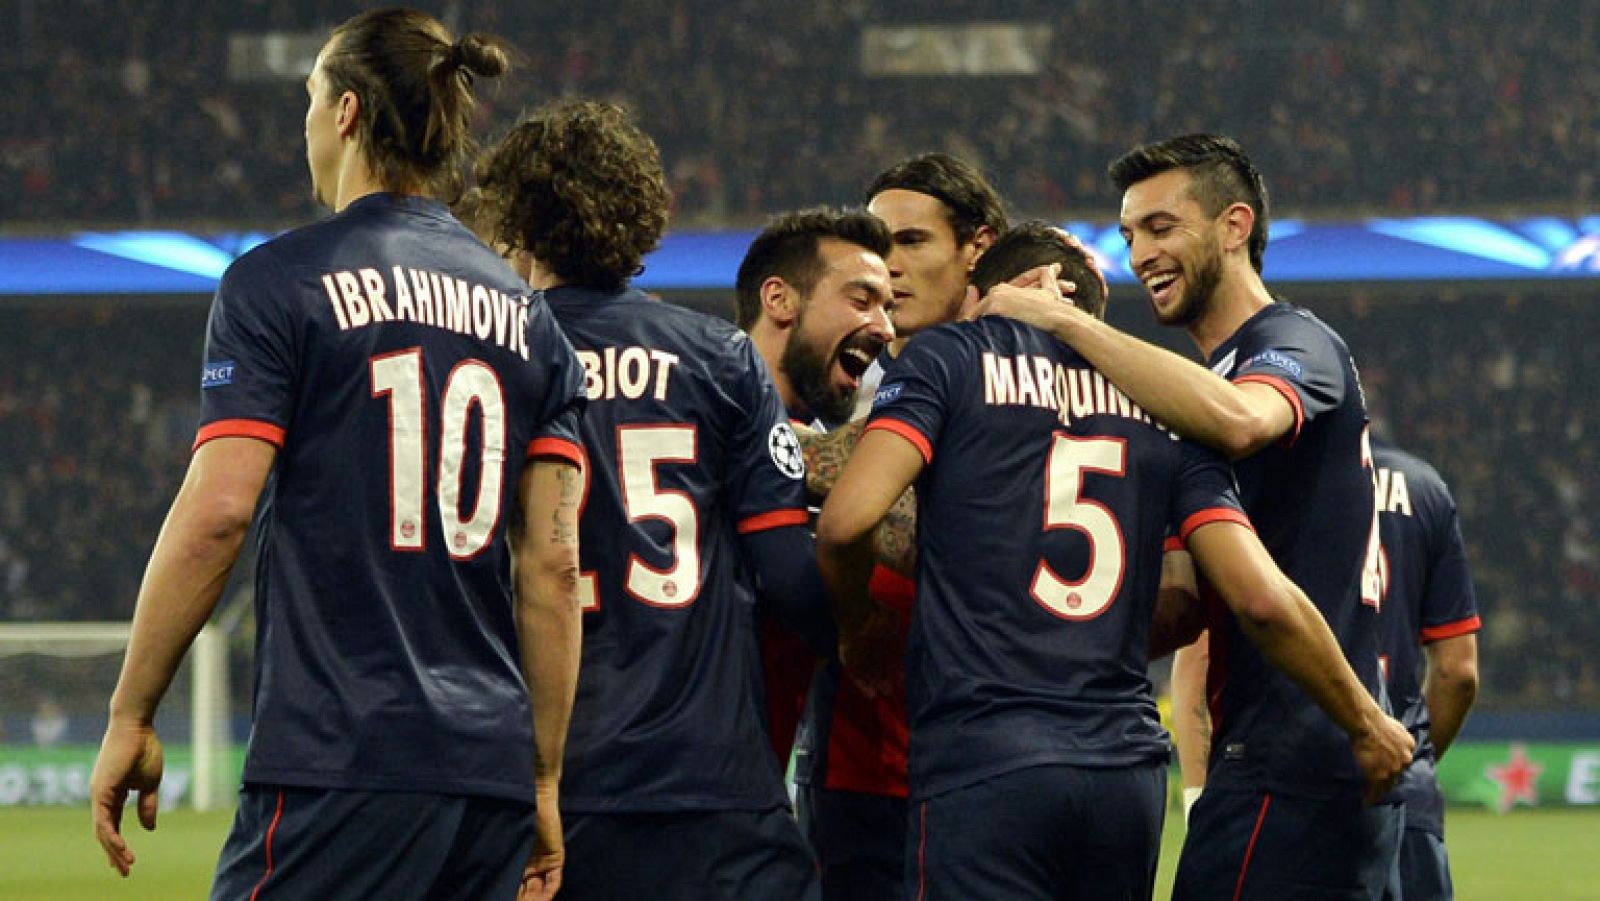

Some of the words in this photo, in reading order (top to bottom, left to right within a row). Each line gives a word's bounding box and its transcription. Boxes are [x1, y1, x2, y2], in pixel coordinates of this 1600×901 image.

[371, 346, 507, 561] 10
[982, 352, 1179, 440] MARQUIN
[580, 423, 700, 611] 5
[1030, 432, 1127, 621] 5
